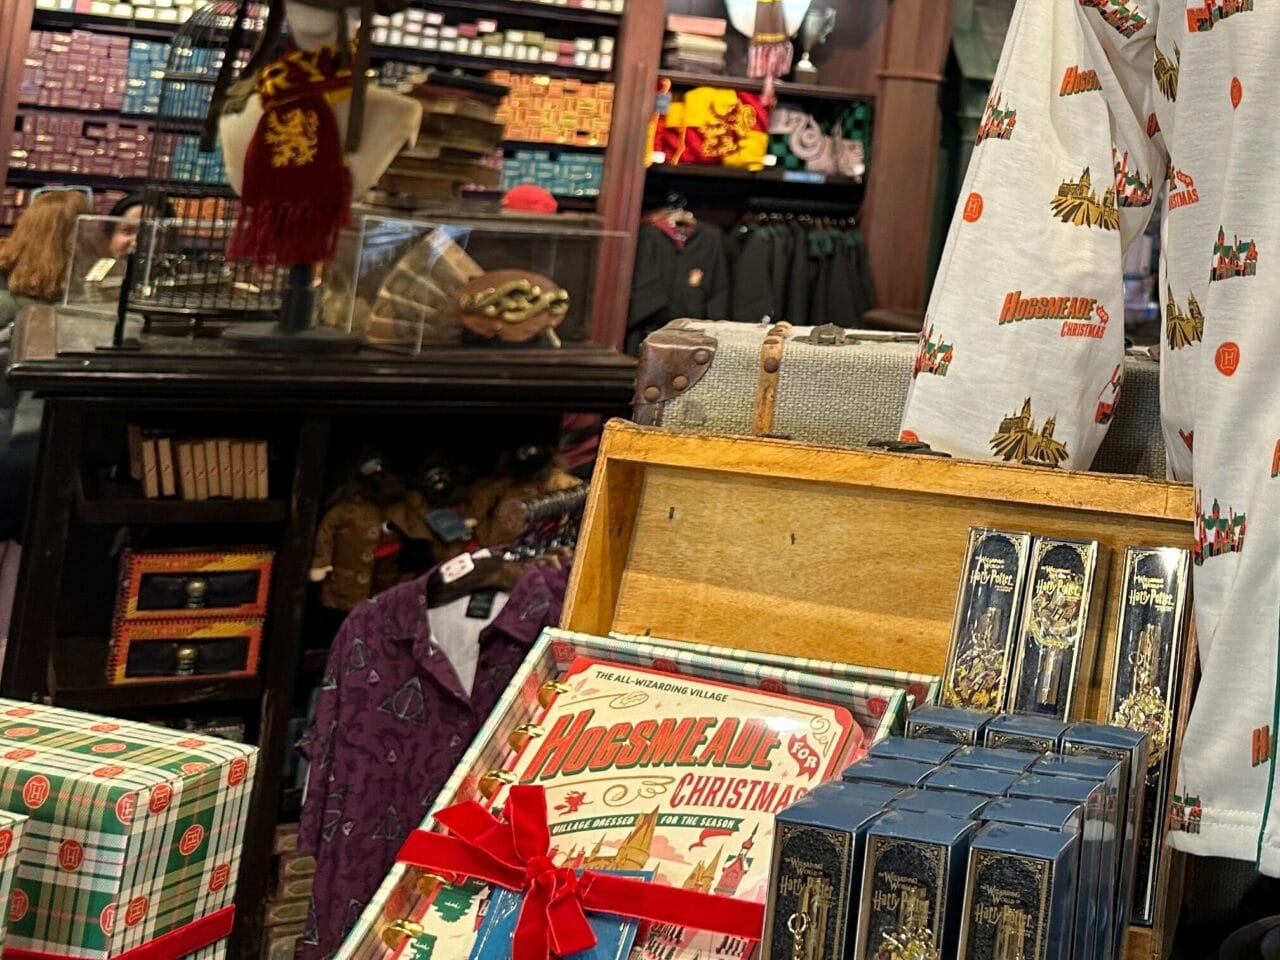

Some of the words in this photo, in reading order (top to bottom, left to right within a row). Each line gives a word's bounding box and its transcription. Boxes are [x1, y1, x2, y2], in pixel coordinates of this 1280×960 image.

[999, 290, 1097, 325] HOGSMEADE
[1061, 321, 1105, 339] CHRISTMAS
[1129, 588, 1151, 606] Harry
[1150, 589, 1174, 607] Potter
[595, 670, 613, 682] THE
[614, 674, 688, 695] ALL-WIZARDING
[690, 688, 729, 702] VILLAGE
[519, 708, 782, 784] HOGSMEADE
[791, 742, 818, 768] FOR
[660, 816, 680, 826] FOR
[682, 817, 698, 826] THE
[700, 818, 735, 829] SEASON
[780, 876, 806, 896] Harry
[873, 891, 900, 911] Harry
[975, 904, 1001, 924] Harry
